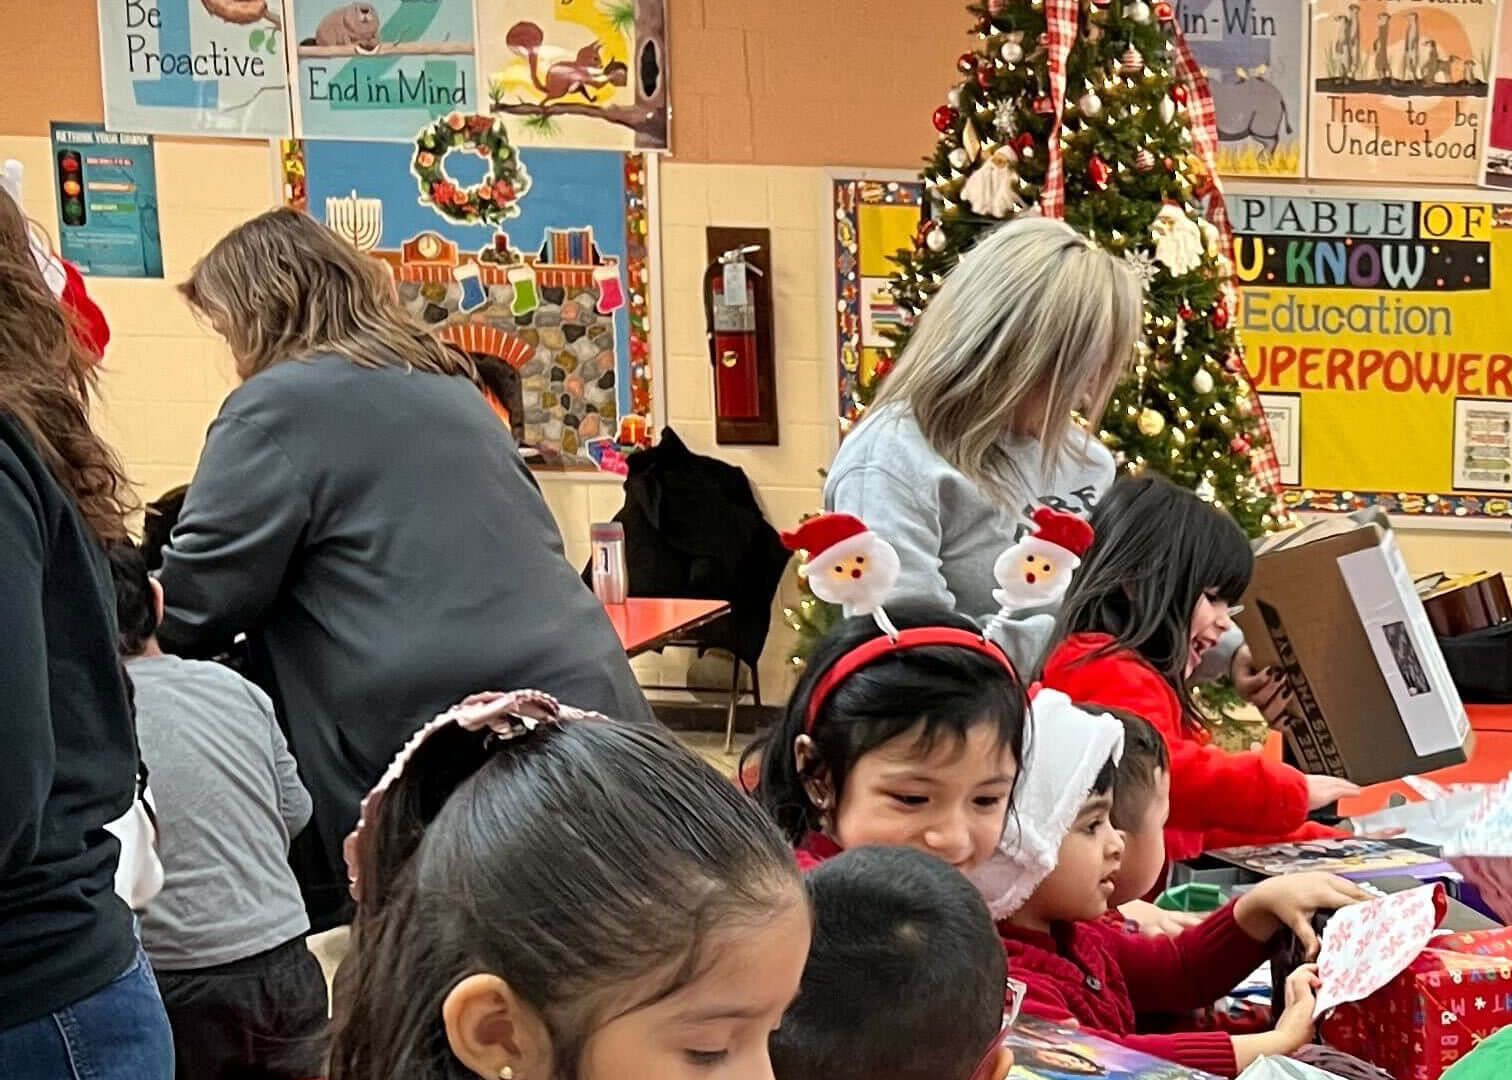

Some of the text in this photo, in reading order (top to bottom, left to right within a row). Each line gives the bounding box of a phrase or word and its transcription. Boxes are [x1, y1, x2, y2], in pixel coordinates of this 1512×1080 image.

[125, 0, 163, 28] Be
[1175, 0, 1278, 36] in-Win
[126, 34, 265, 77] Proactive
[308, 66, 467, 105] End in Mind
[1326, 96, 1478, 127] Then to be
[1326, 124, 1477, 161] Understood
[1423, 206, 1485, 238] OF
[1286, 241, 1425, 289] KNOW
[1243, 292, 1452, 336] Education
